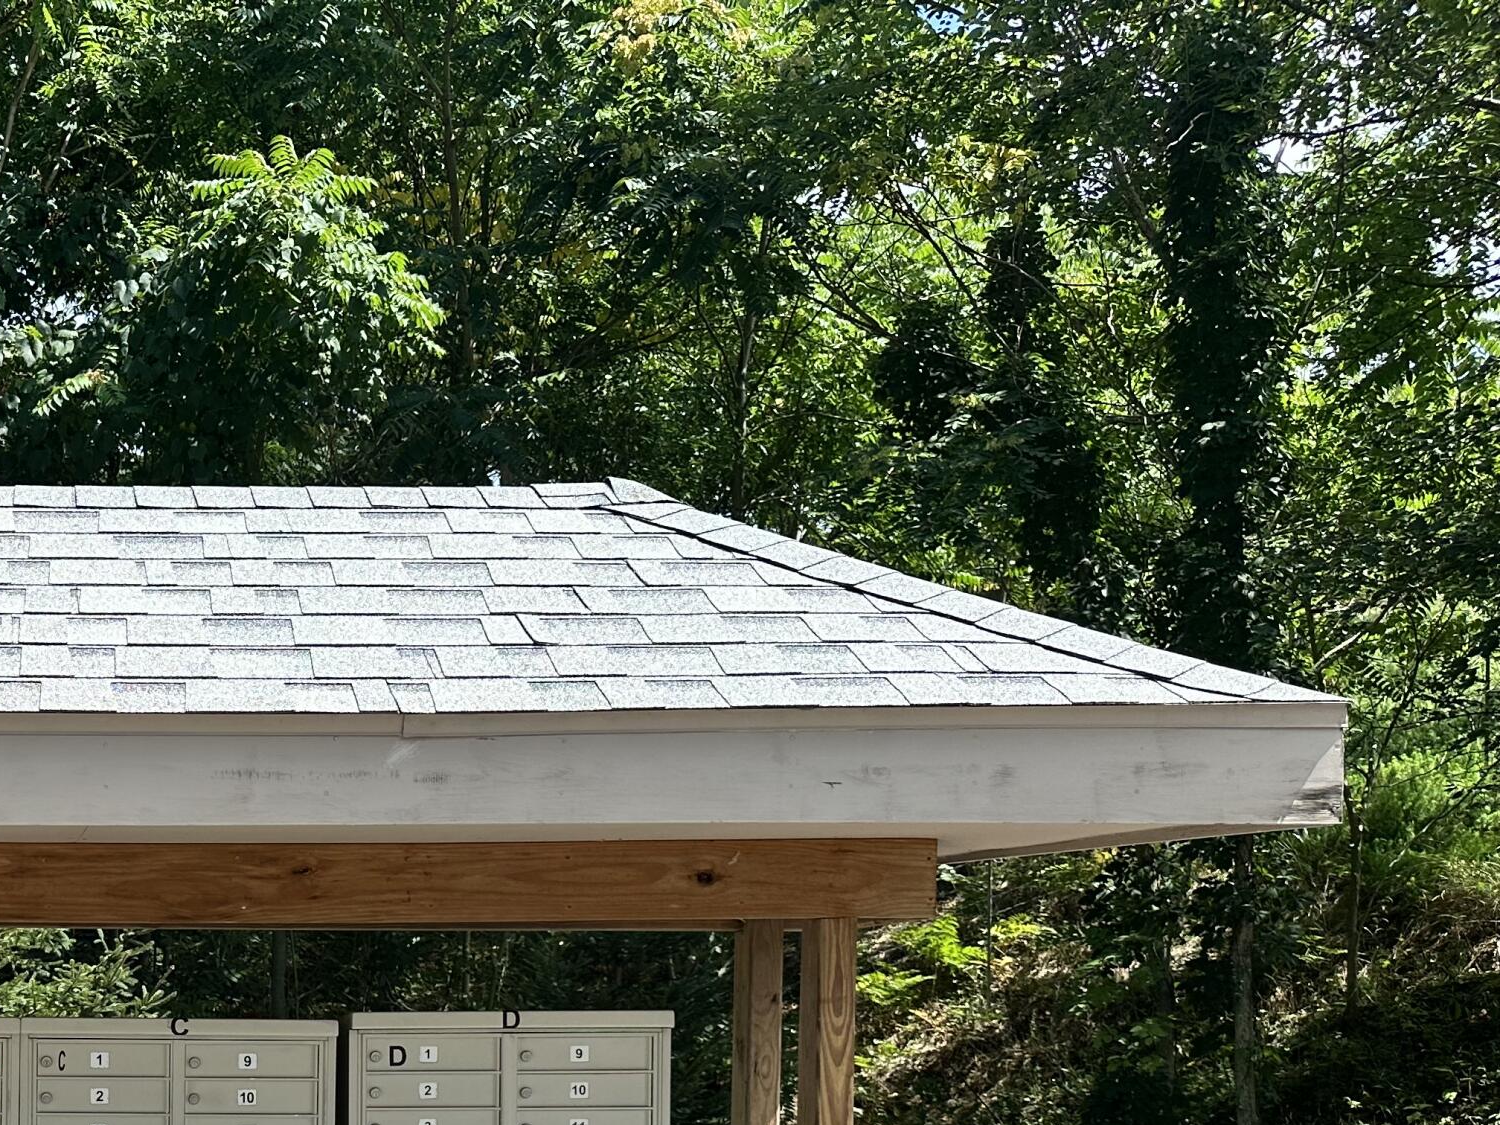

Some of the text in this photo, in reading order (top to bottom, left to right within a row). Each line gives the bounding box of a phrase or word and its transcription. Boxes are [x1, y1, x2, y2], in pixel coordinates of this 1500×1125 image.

[502, 1009, 520, 1029] D
[170, 1017, 189, 1036] C
[96, 1053, 102, 1066] 1
[388, 1045, 407, 1067] D
[424, 1048, 431, 1060] 1
[575, 1048, 583, 1059] 9
[57, 1050, 66, 1072] C
[243, 1055, 252, 1068] 9
[95, 1090, 104, 1102] 2
[424, 1084, 432, 1096] 2
[571, 1084, 587, 1096] 10
[239, 1091, 255, 1104] 10
